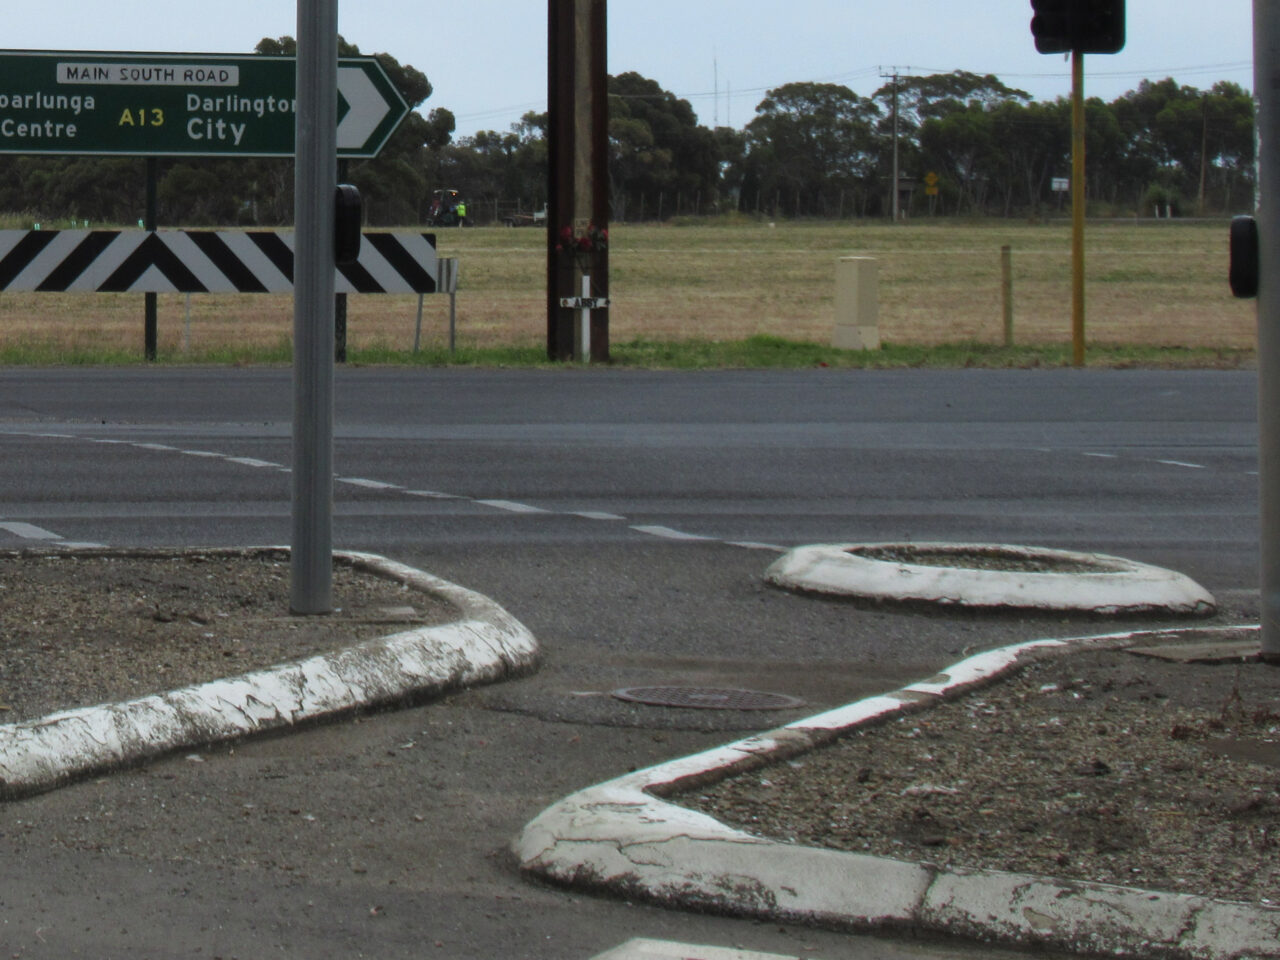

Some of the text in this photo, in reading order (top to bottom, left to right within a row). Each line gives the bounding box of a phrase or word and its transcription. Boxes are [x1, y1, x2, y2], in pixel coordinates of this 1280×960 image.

[66, 66, 230, 82] MAIN SOUTH ROAD
[118, 108, 165, 127] A13
[1, 118, 78, 138] Centre
[186, 117, 246, 146] City
